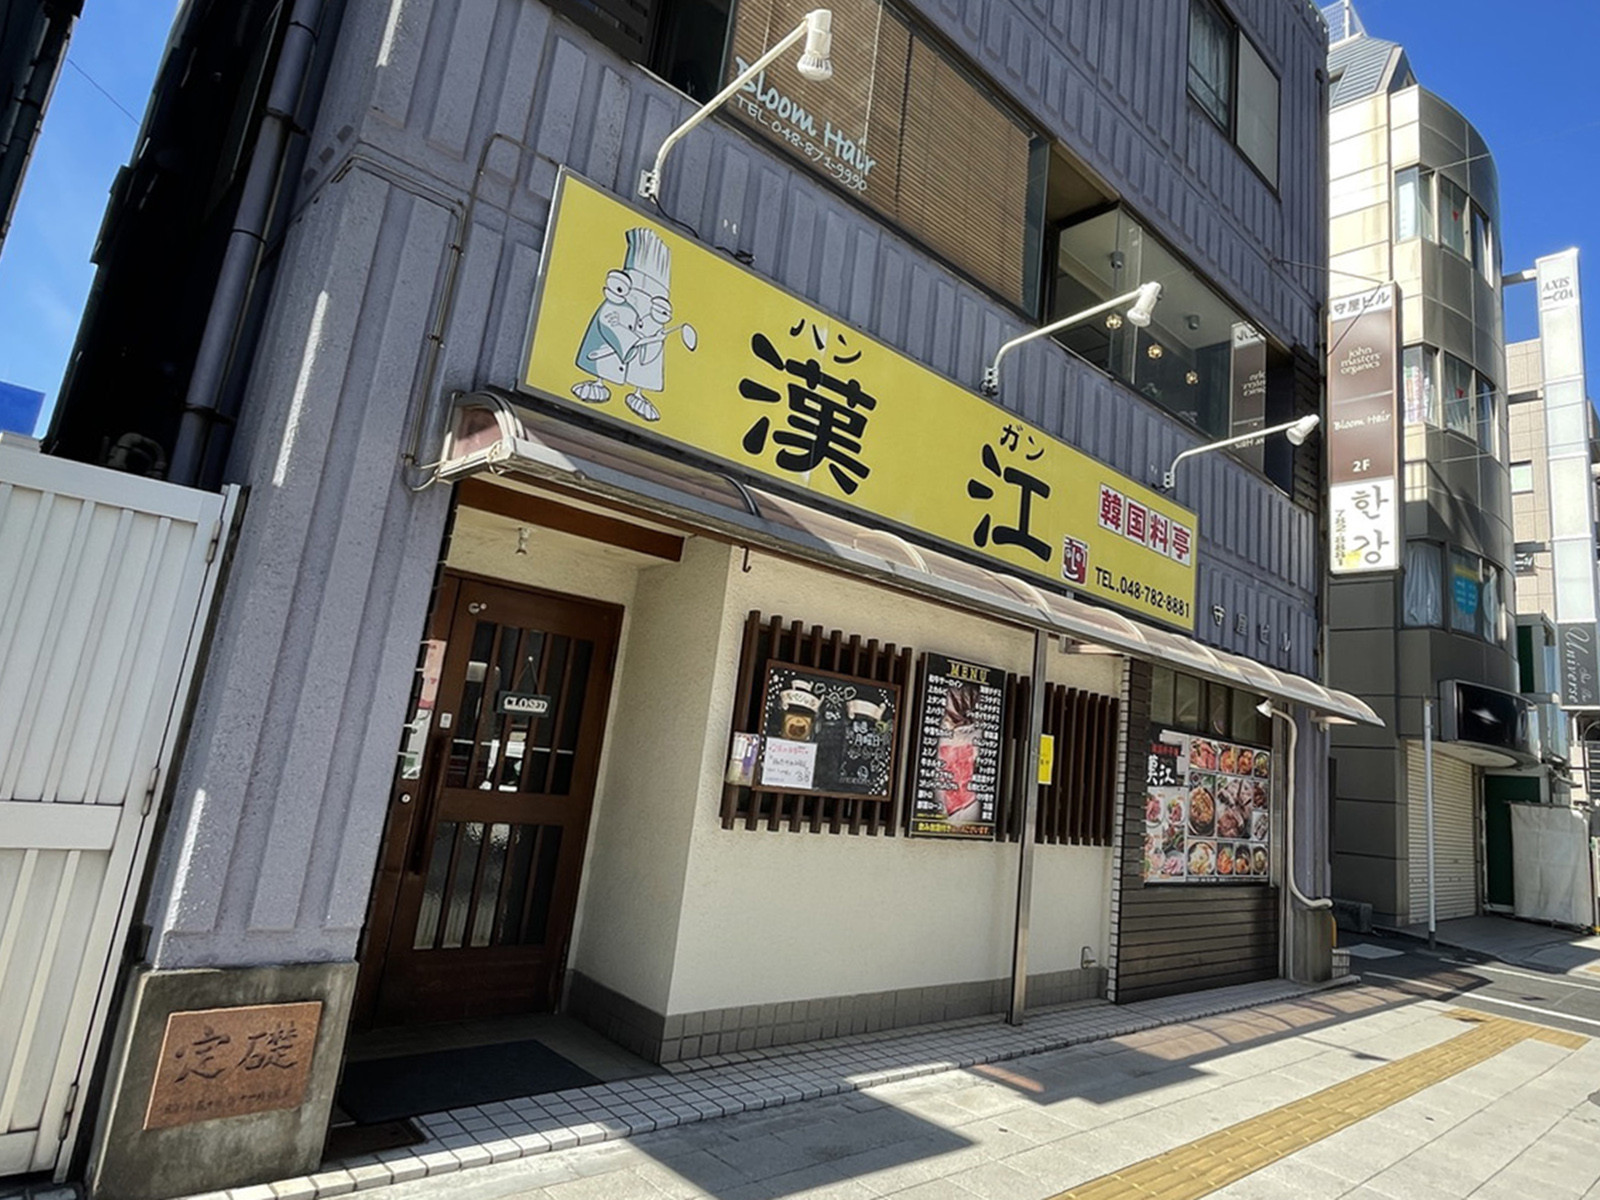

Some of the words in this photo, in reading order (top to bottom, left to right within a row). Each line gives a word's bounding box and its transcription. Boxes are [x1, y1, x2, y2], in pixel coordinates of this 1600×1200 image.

[735, 56, 816, 136] Bloom
[824, 122, 876, 176] Hair
[736, 94, 769, 126] TEL
[1334, 292, 1390, 315] 守屋ビル
[789, 318, 863, 365] ハン
[1333, 419, 1365, 431] Bloom
[1367, 411, 1392, 425] Hair
[999, 422, 1046, 463] ガン
[1352, 459, 1371, 472] 2F
[1099, 489, 1191, 561] 韓国料亭
[1351, 485, 1390, 565] 한강
[950, 662, 987, 683] MENU
[1565, 627, 1591, 703] Universe
[503, 696, 549, 713] CLOSED
[172, 1020, 300, 1084] 定礎
